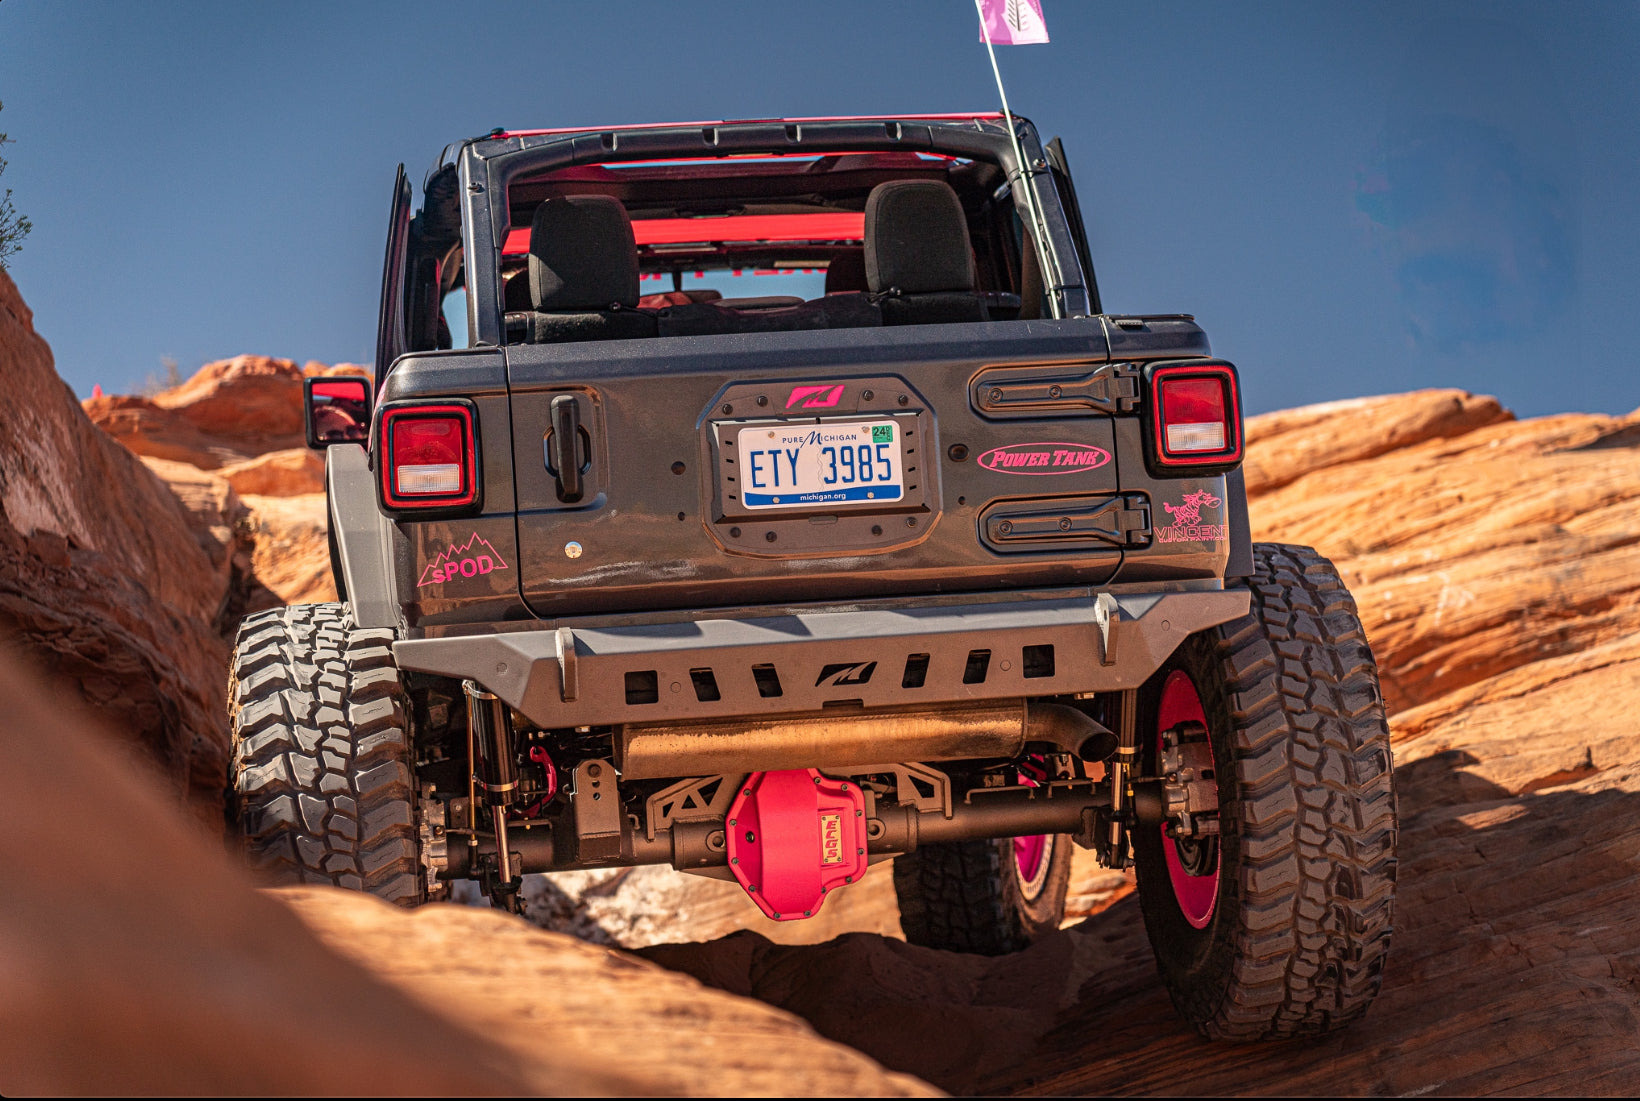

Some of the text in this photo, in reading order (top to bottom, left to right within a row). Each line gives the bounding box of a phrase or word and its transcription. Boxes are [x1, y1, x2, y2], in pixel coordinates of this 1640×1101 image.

[800, 431, 857, 448] MICHIGAN
[873, 427, 885, 436] 24
[750, 444, 891, 488] ETY 3985
[989, 450, 1100, 467] POWER TANK
[800, 493, 846, 502] michigan.org
[825, 820, 838, 858] ECGS
